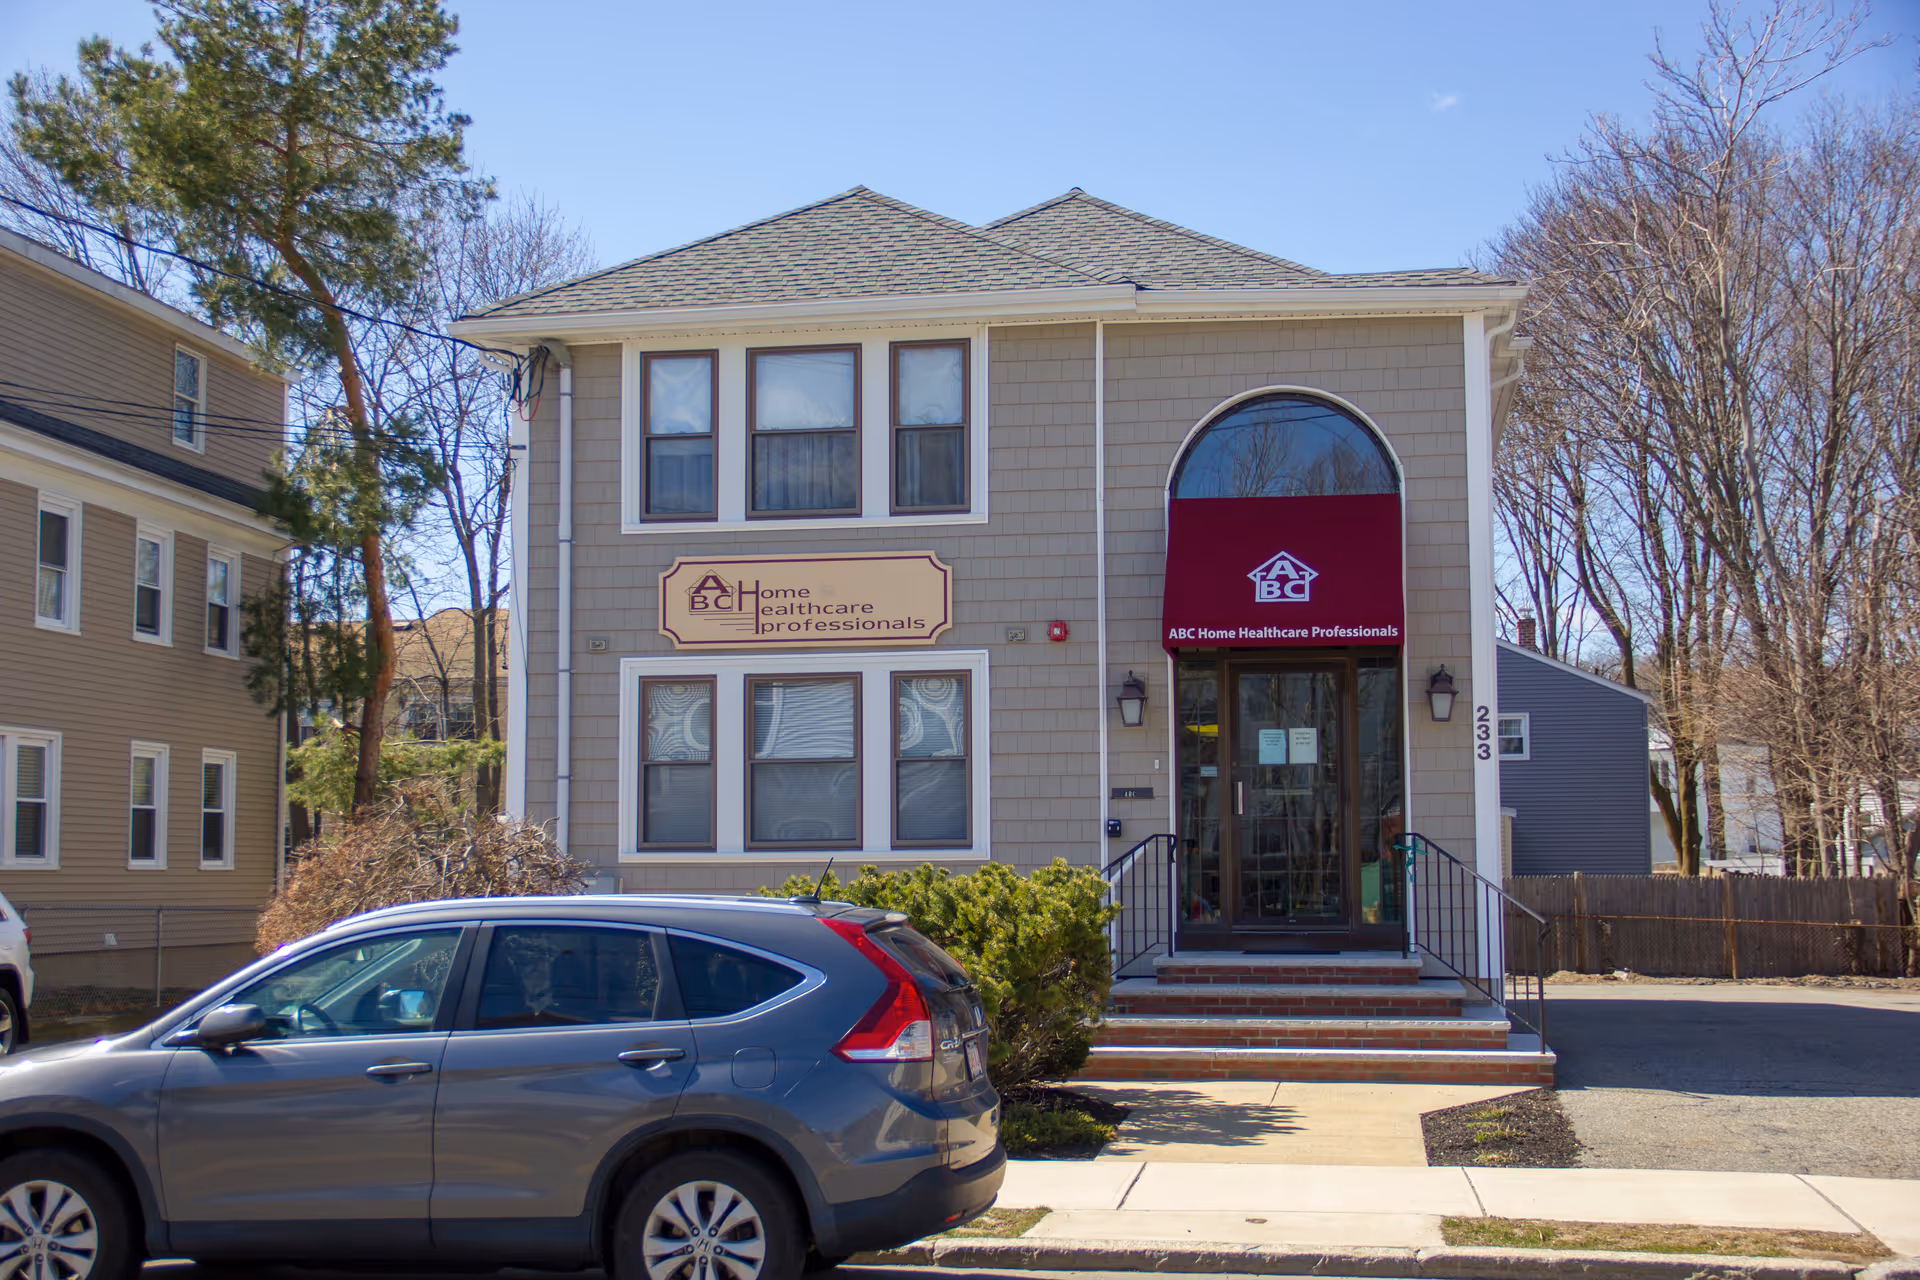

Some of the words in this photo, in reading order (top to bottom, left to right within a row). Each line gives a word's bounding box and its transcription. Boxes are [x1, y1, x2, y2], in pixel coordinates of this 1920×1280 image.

[738, 580, 811, 634] Home
[761, 616, 926, 634] professionals
[1169, 628, 1195, 639] ABC
[1198, 627, 1236, 639] Home
[1239, 626, 1309, 639] Healthcare
[1312, 625, 1399, 638] Professionals
[1476, 705, 1491, 760] 233
